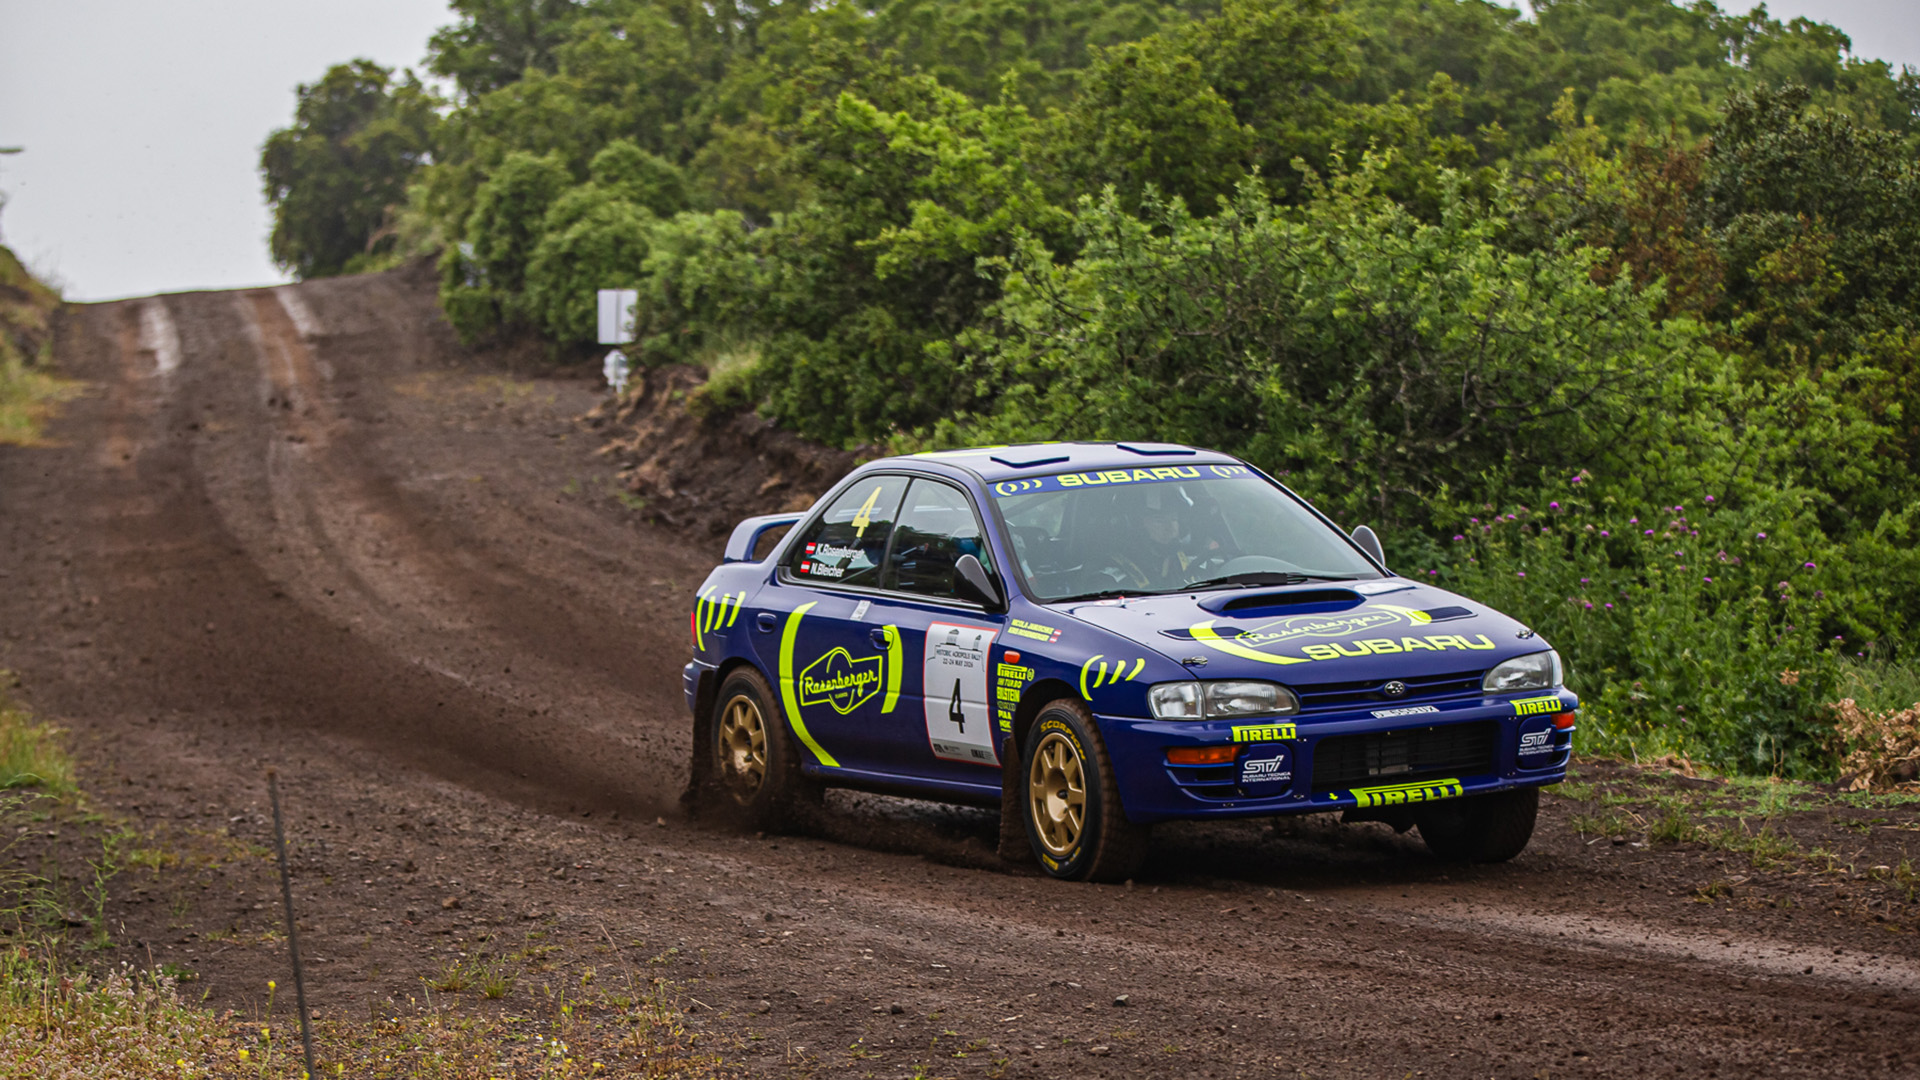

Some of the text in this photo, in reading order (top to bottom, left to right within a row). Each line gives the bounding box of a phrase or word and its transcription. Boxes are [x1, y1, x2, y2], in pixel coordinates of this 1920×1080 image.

[1057, 466, 1201, 487] SUBARU
[851, 486, 882, 538] 4
[1301, 633, 1496, 661] SUBARU
[997, 663, 1028, 680] PIRELLI
[949, 678, 965, 734] 4
[1510, 695, 1562, 716] PIRELLI
[1040, 720, 1086, 761] SCORPION
[1231, 723, 1297, 742] PIRELLI
[1349, 777, 1464, 808] PIRELLI
